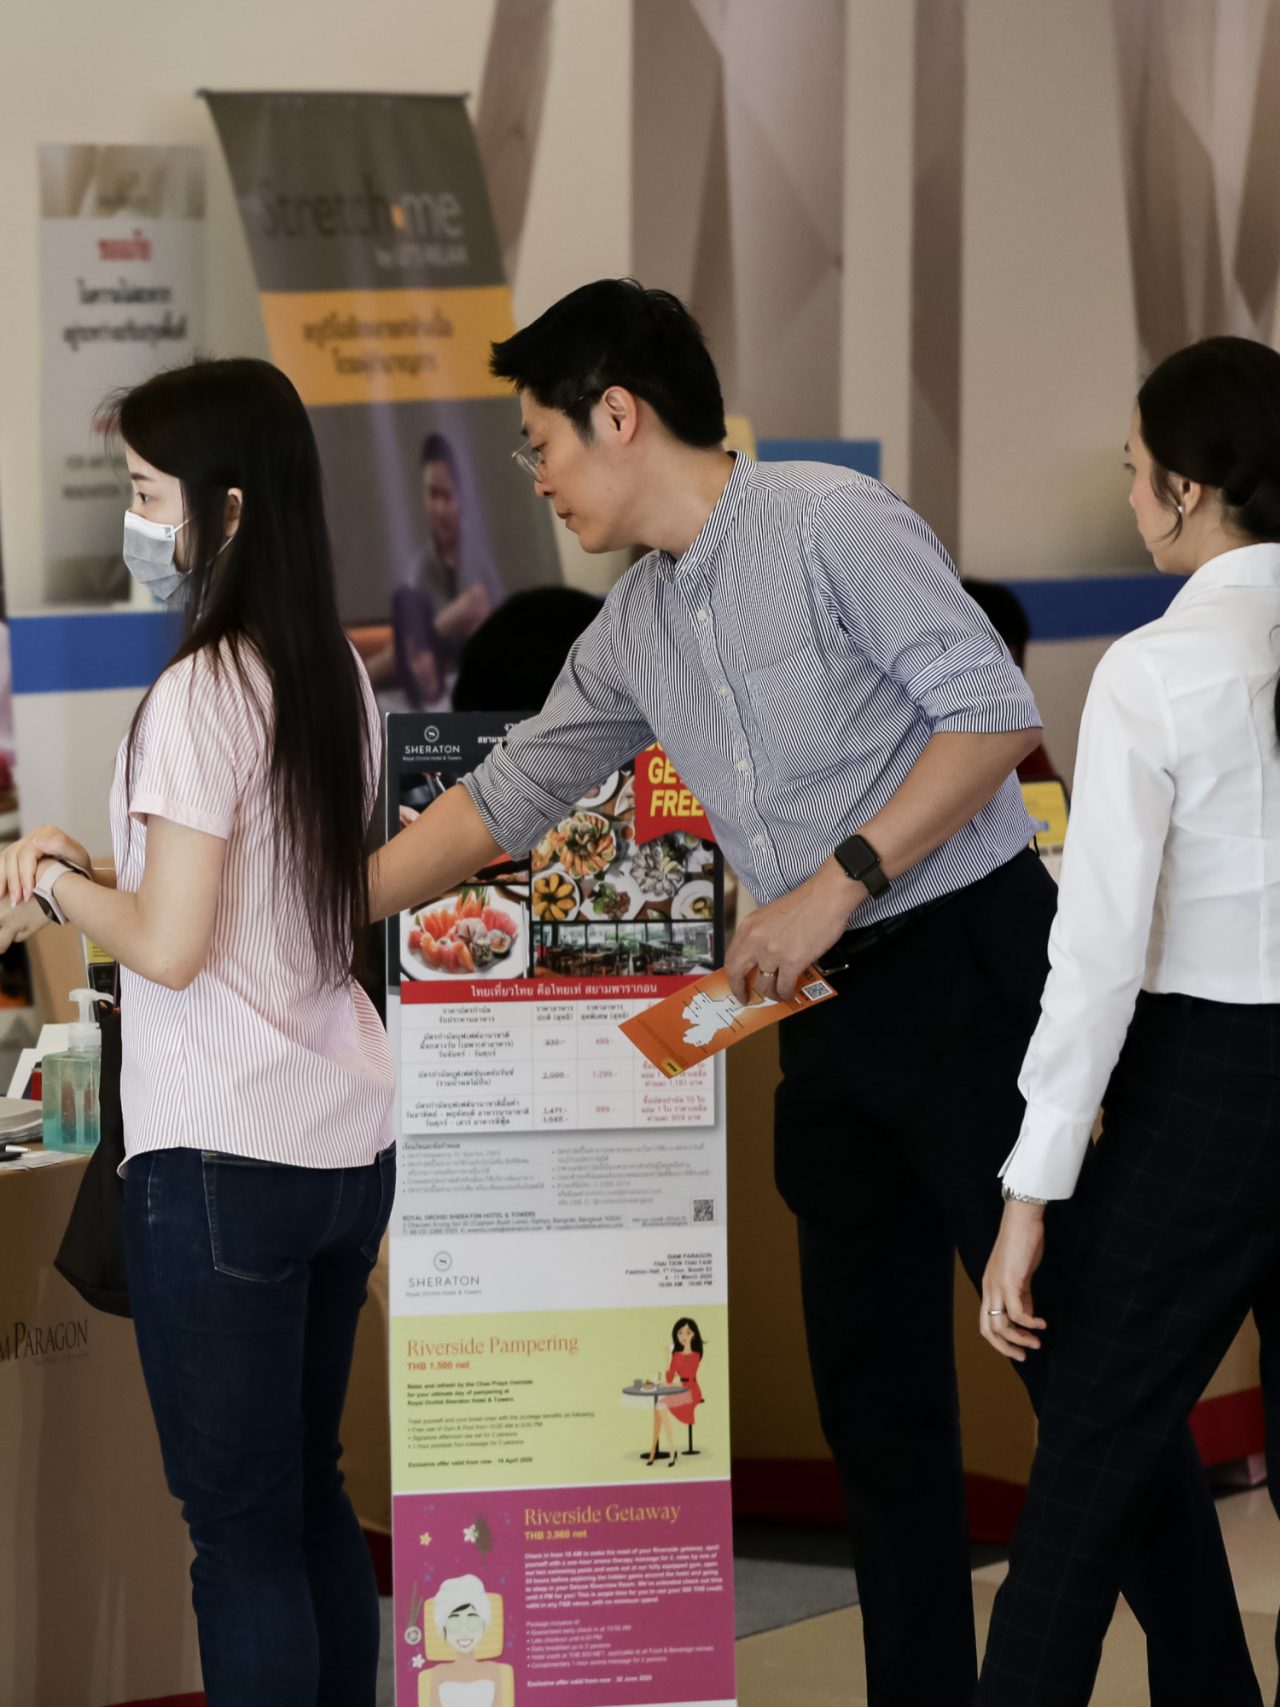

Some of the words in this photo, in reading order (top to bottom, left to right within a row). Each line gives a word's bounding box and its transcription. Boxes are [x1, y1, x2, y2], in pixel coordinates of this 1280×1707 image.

[405, 745, 461, 754] SHERATON
[648, 757, 683, 784] GE
[471, 984, 533, 997] ไทยเที่ยวไทย
[585, 984, 658, 994] สยามพารากอน
[408, 1275, 480, 1288] SHERATON
[407, 1337, 484, 1357] Riverside
[489, 1334, 578, 1357] Pampering
[407, 1362, 426, 1370] THB
[455, 1361, 470, 1369] net
[524, 1506, 601, 1526] Riverside
[605, 1503, 681, 1523] Getaway
[524, 1531, 544, 1540] THB
[572, 1529, 587, 1538] net
